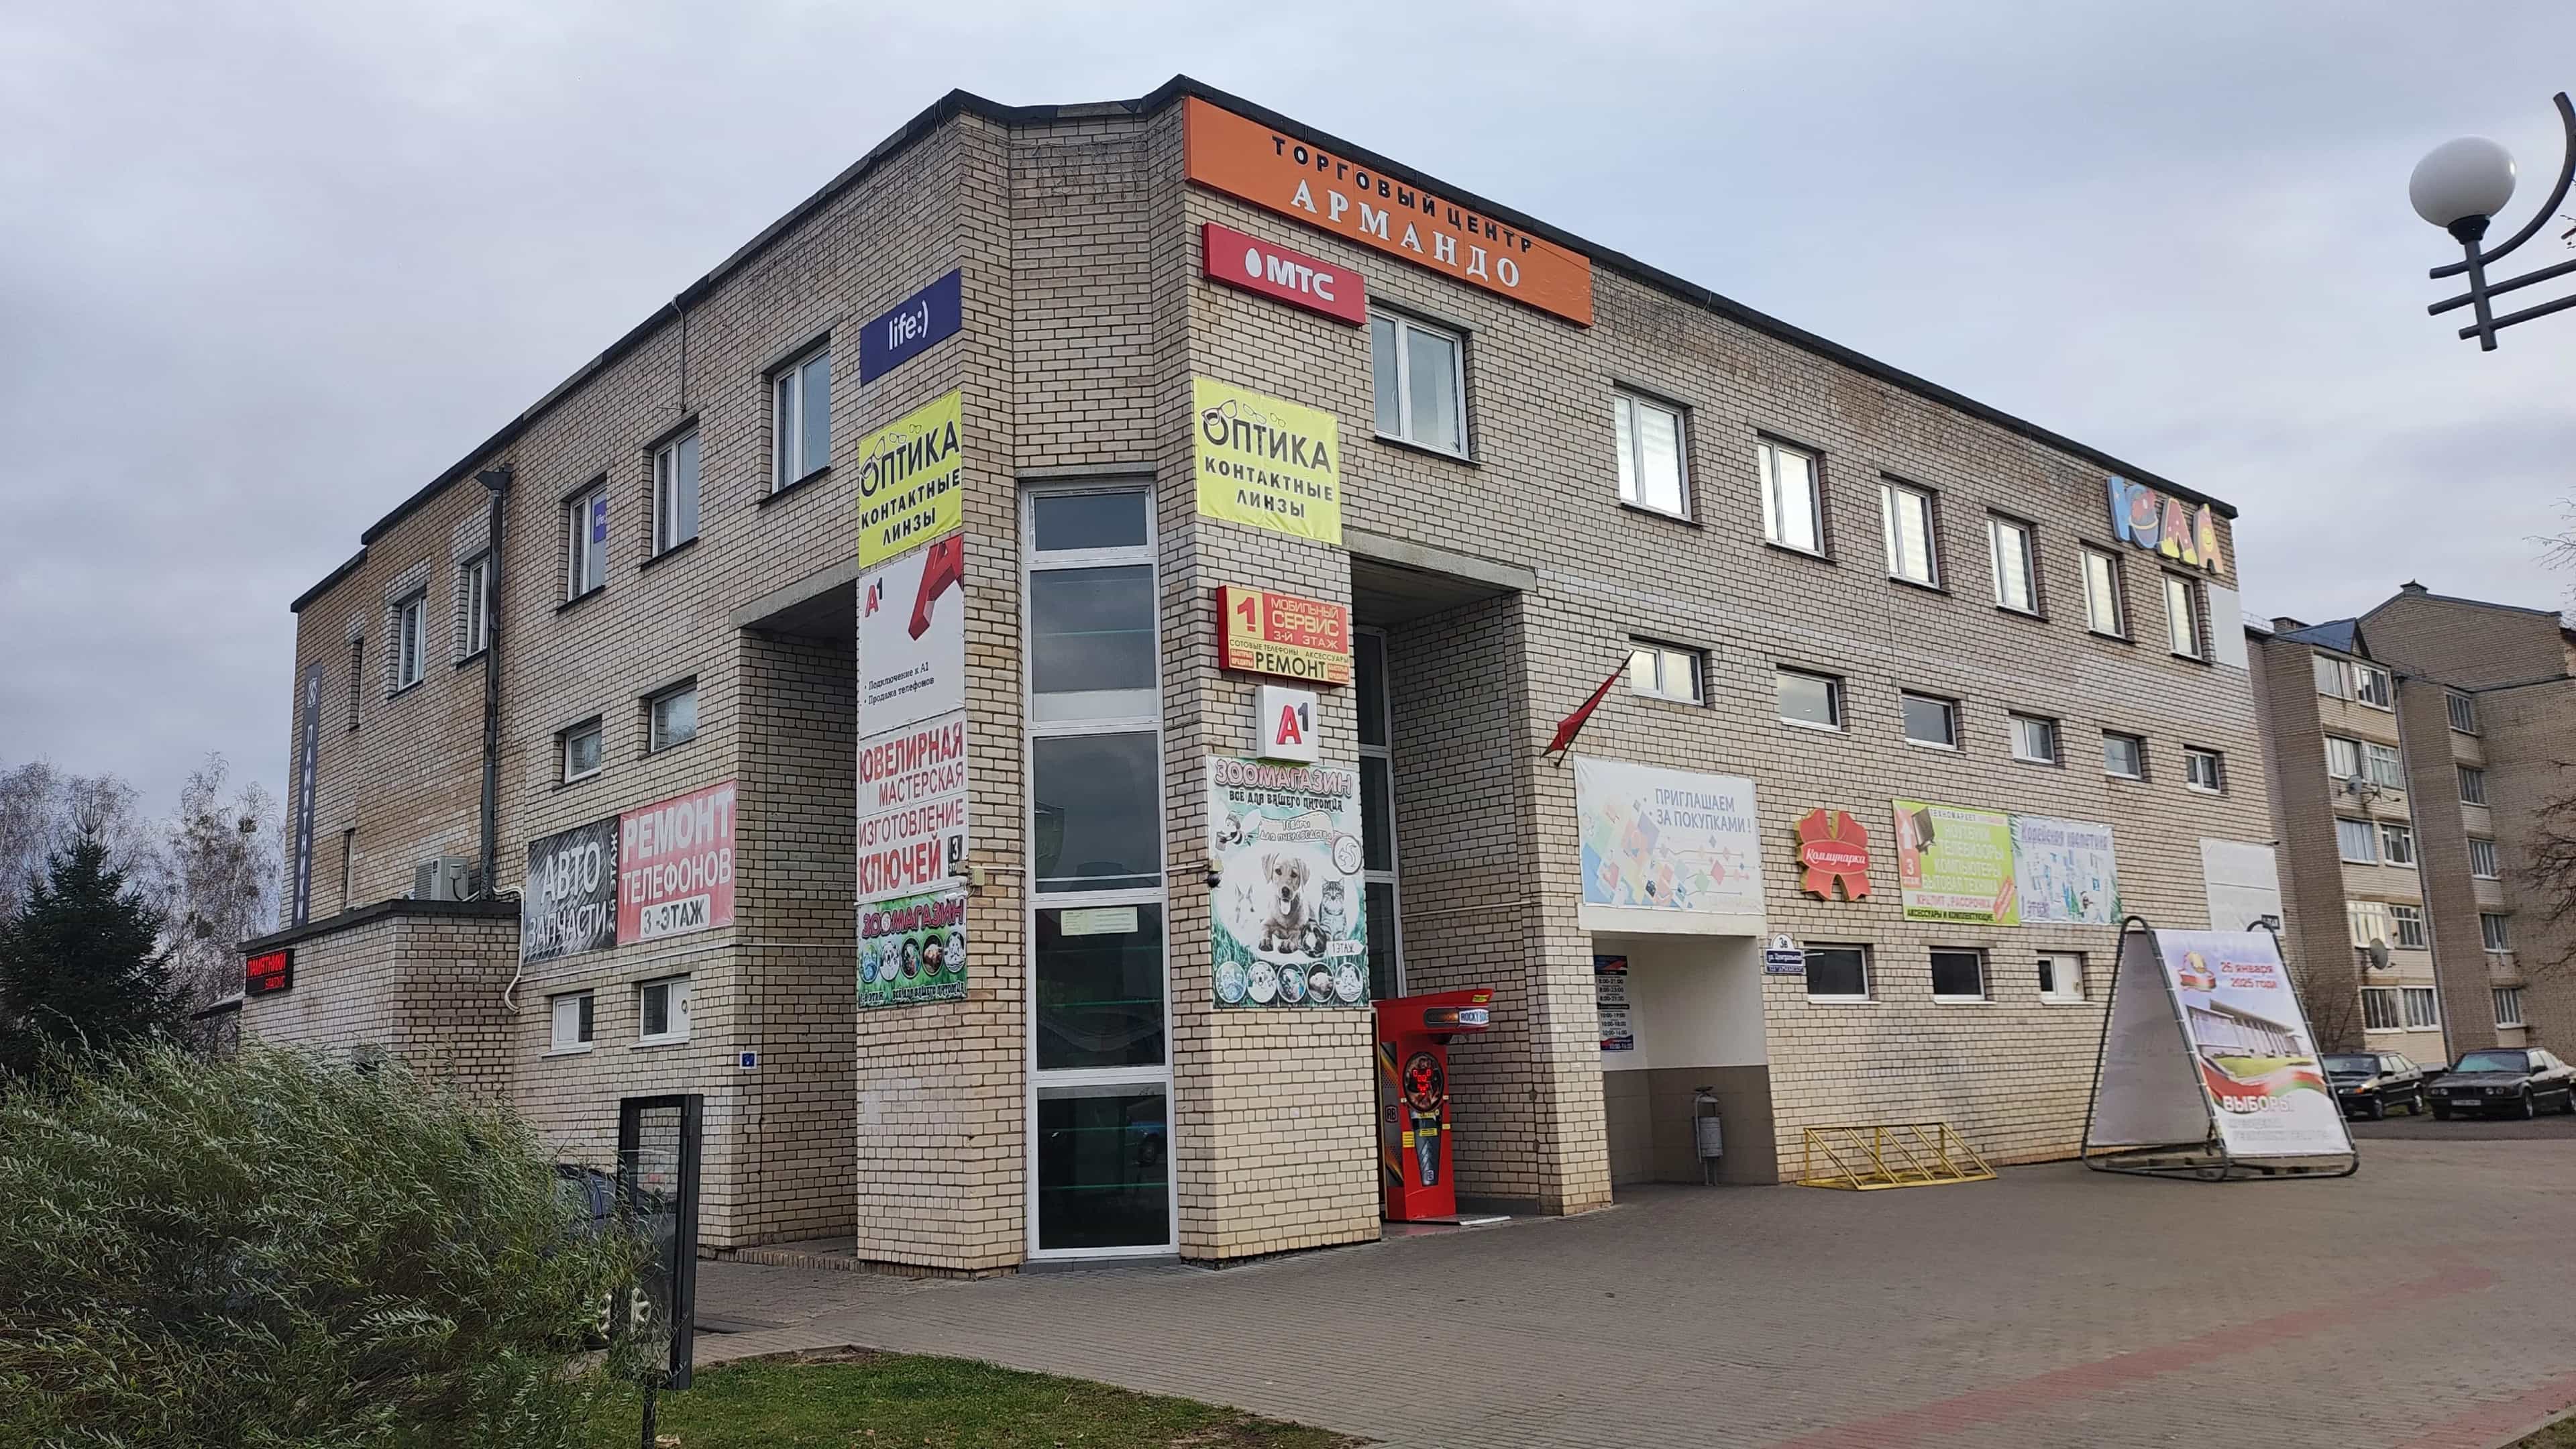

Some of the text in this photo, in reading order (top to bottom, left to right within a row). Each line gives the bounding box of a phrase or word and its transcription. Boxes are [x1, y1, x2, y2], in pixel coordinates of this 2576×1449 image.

[1272, 136, 1532, 253] ТОРГОВЫЙ ЦЕНТР
[1291, 178, 1520, 288] АРМАНДО
[1267, 254, 1336, 302] МТС
[888, 299, 929, 352] life:)
[861, 420, 960, 497] ОПТИКА
[1203, 411, 1332, 474] ОПТИКА
[861, 468, 960, 530] КОНТАКТНЫЕ
[1205, 455, 1334, 502] КОНТАКТНЫЕ
[1237, 489, 1305, 519] ЛИНЗЫ
[883, 508, 936, 546] ЛИНЗЫ
[1270, 597, 1339, 619] МОБИЛЬНЫЙ
[1272, 610, 1339, 637] СЕРВИС
[1229, 639, 1348, 663] СОТОВЫЕ ТЕЛЕФОНЫ АКСЕССУАРЫ
[1273, 630, 1338, 650] 3-Й ЭТАЖ
[869, 669, 913, 690] Подключение
[1255, 651, 1326, 678] РЕМОНТ
[868, 676, 934, 704] Продажа телефонов
[859, 720, 963, 785] ЮВЕЛИРНАЯ
[878, 761, 964, 808] МАСТЕРСКАЯ
[1214, 758, 1353, 799] ЗООМАГАЗИН
[1229, 788, 1344, 812] ВСЁ ДЛЯ ВАШЕГО ПИТОМЦА
[1655, 788, 1735, 812] ПРИГЛАШАЕМ
[1656, 809, 1672, 826] ЗА
[297, 723, 314, 920] ПАМЯТНИКИ
[622, 792, 734, 863] РЕМОНТ
[859, 798, 964, 849] ИЗГОТОВЛЕНИЕ
[609, 830, 619, 894] ЭТАЖ
[859, 835, 941, 896] КЛЮЧЕЙ
[953, 837, 959, 861] 3
[1805, 847, 1866, 867] Коммунарка
[1907, 858, 1914, 875] 3
[541, 841, 601, 904] АВТО
[622, 847, 731, 905] ТЕЛЕФОНОВ
[529, 901, 606, 949] ЗАПЧАСТИ
[861, 898, 965, 940] ЗООМАГАЗИН
[1907, 908, 1942, 918] АКСЕССУАРЫ
[2222, 1094, 2293, 1113] ВЫБОРЫ
